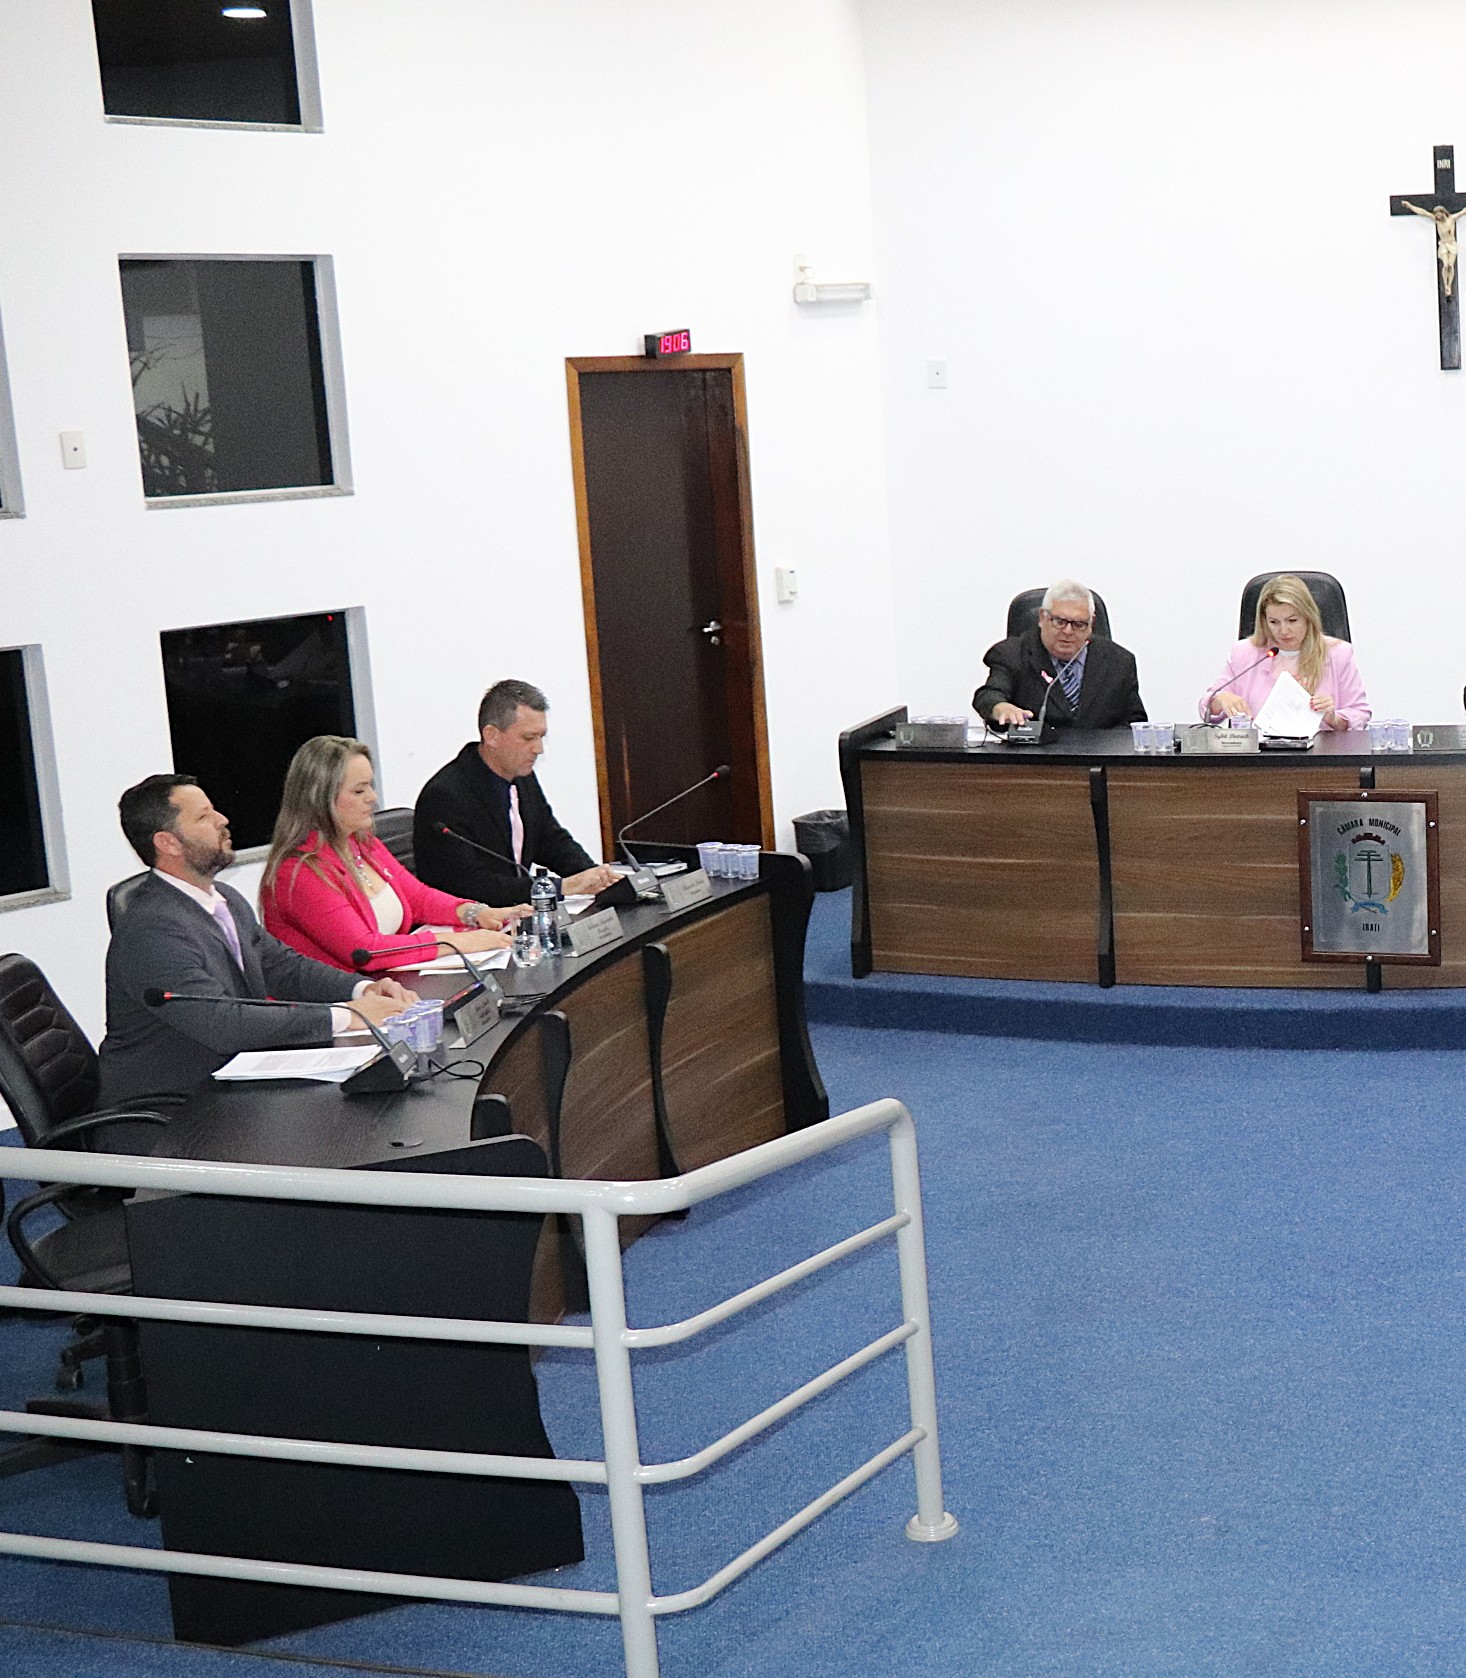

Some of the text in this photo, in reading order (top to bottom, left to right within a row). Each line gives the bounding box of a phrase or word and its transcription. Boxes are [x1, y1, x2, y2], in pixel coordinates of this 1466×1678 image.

[1437, 159, 1451, 169] INRI
[660, 331, 689, 354] 1906
[1362, 923, 1380, 932] IRATI
